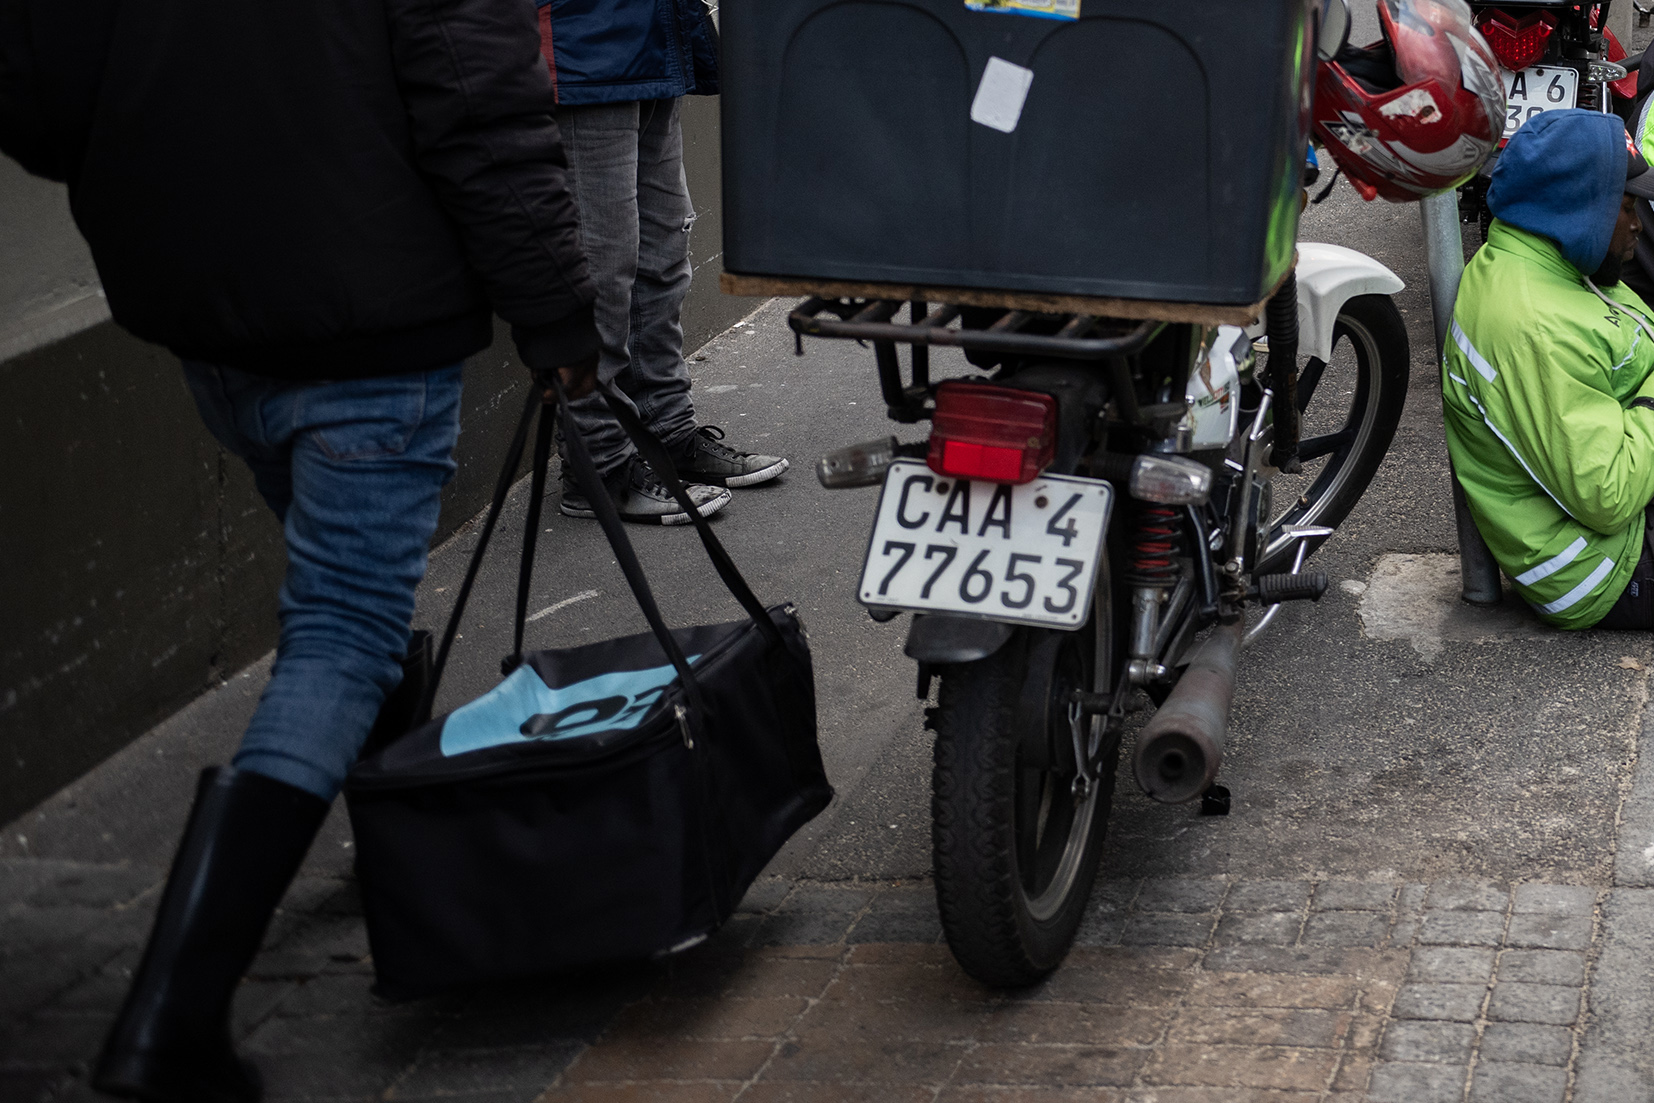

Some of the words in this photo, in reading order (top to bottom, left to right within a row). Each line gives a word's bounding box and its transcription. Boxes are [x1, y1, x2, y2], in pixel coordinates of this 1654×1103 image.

[1547, 74, 1565, 103] 6
[896, 474, 1013, 539] CAA
[1046, 493, 1083, 547] 4
[878, 540, 1084, 615] 77653
